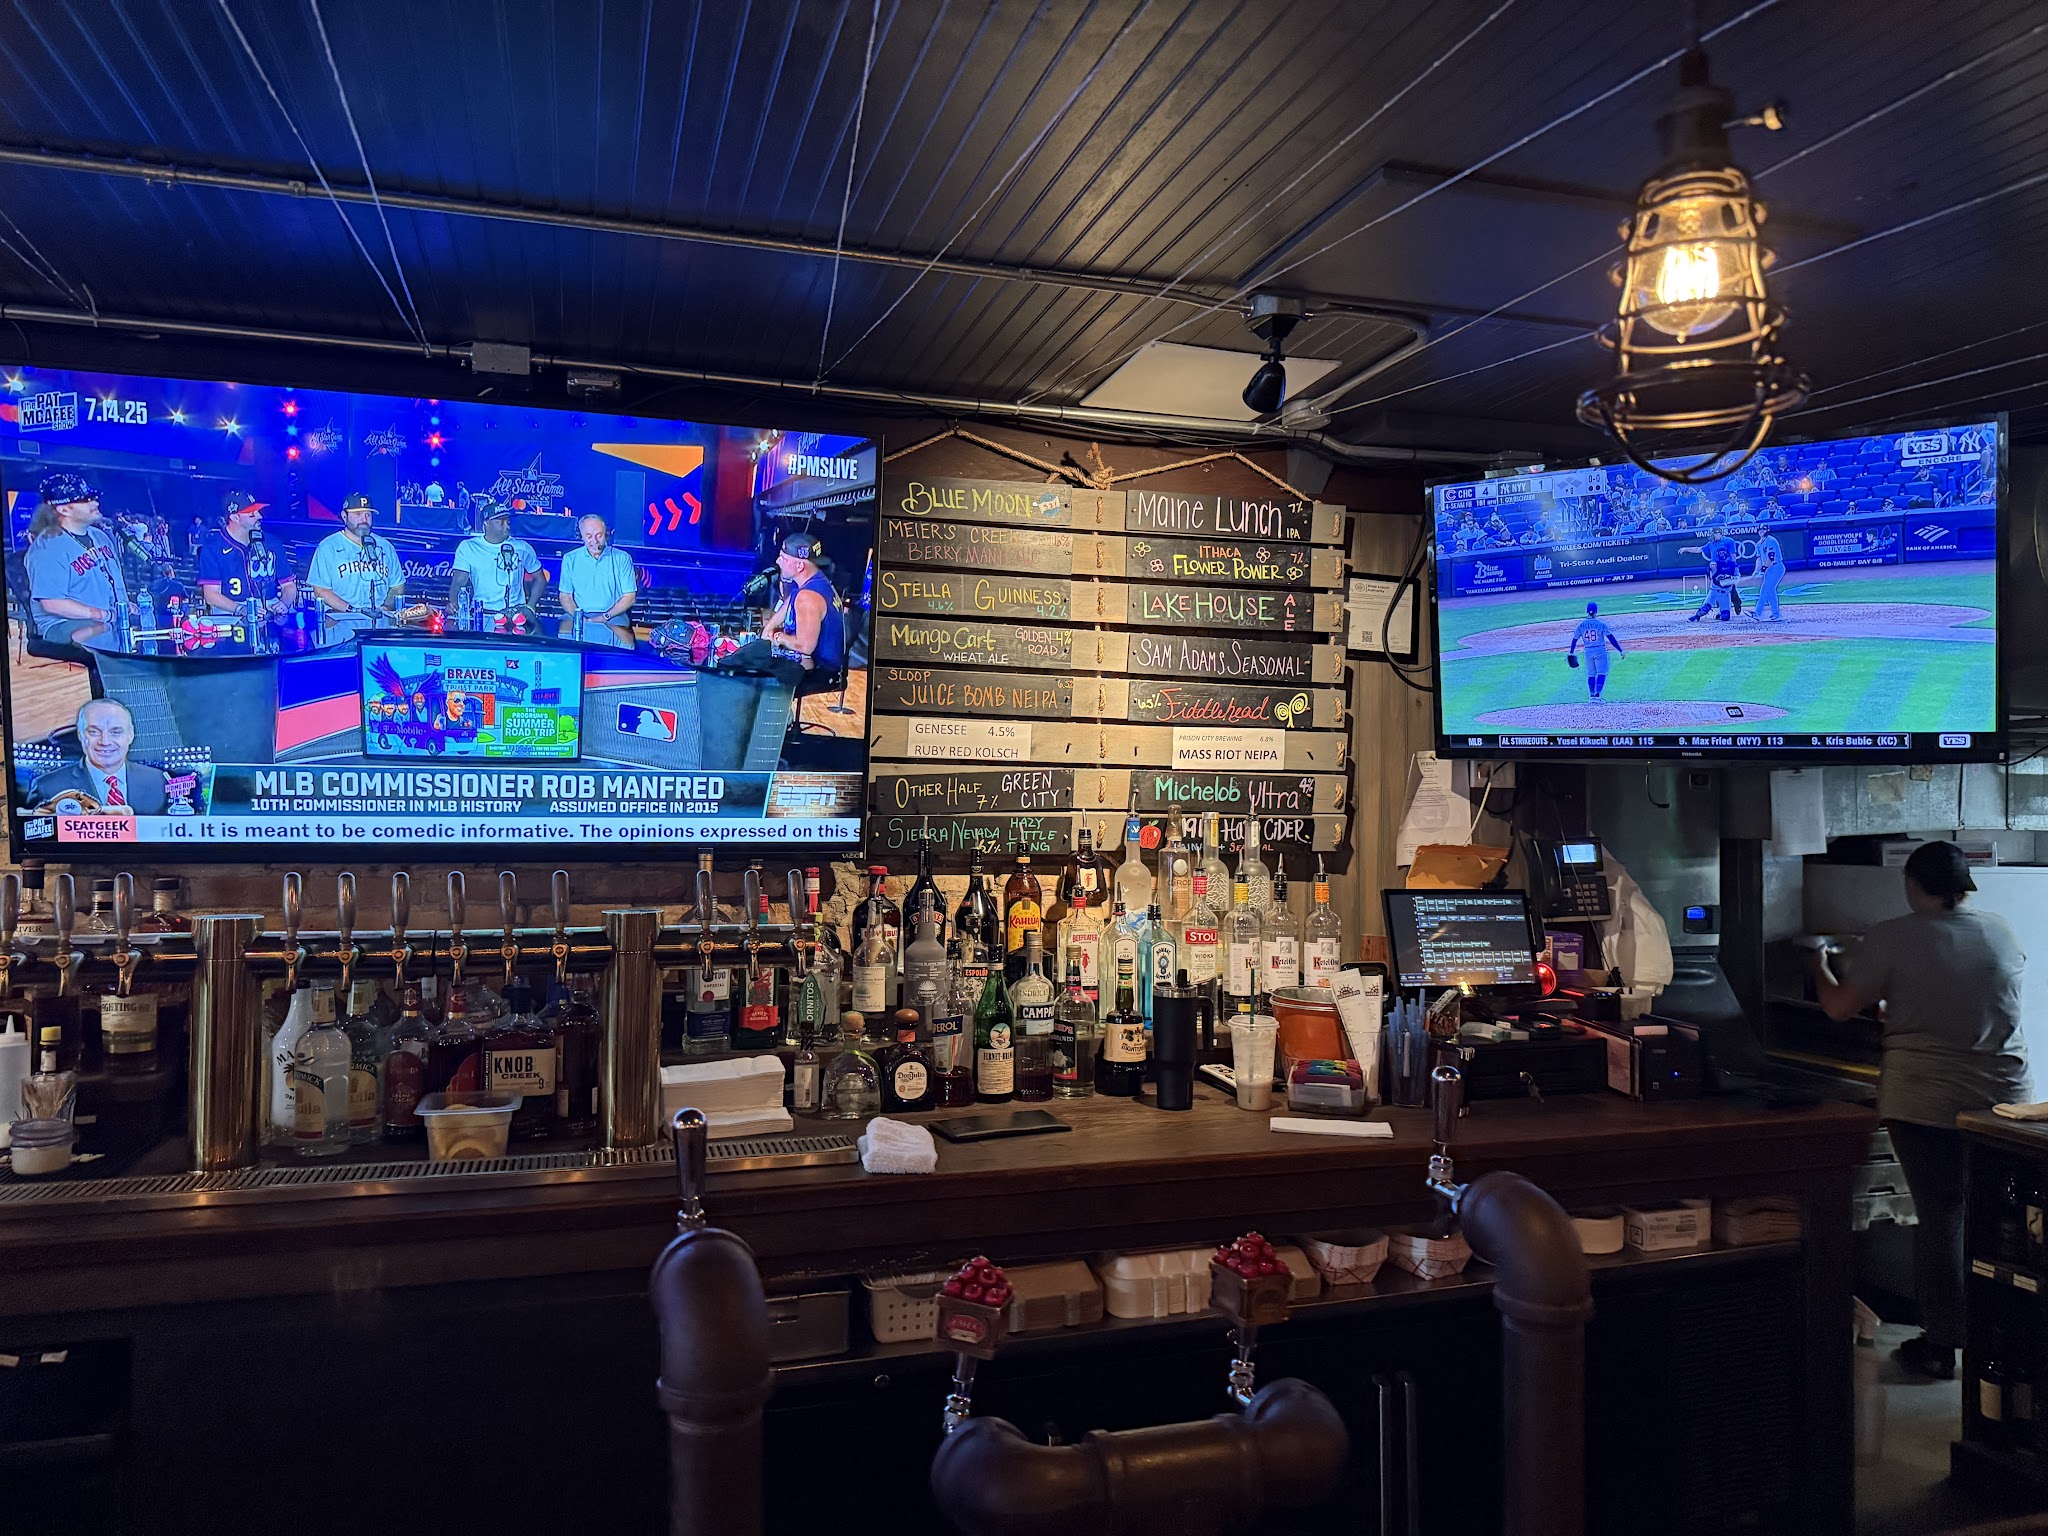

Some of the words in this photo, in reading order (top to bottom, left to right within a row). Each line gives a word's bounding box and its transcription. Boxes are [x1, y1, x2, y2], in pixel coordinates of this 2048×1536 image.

[36, 392, 60, 408] PAT
[23, 406, 75, 425] MCAFEE
[85, 398, 148, 424] 7.14.25
[53, 422, 73, 430] show
[1909, 438, 1942, 453] YES
[788, 454, 858, 480] #PMSLIVE
[1918, 455, 1962, 465] ENCORE
[512, 478, 536, 494] Star
[1457, 489, 1473, 498] CHC
[1482, 487, 1489, 495] 4
[1512, 483, 1526, 492] NYY
[1538, 481, 1544, 489] 1
[901, 482, 968, 516] BLUE
[972, 488, 1032, 517] MOON
[1138, 491, 1204, 530] Maine
[1215, 496, 1283, 538] Lunch
[1288, 501, 1304, 514] 7%
[889, 520, 956, 541] MEIER'S
[970, 527, 1018, 546] CREEK
[1287, 527, 1301, 540] IPA
[908, 542, 962, 562] BERRY
[1200, 545, 1242, 559] ITHACA
[1291, 552, 1305, 565] 7%
[1173, 554, 1230, 576] FLOWER
[1232, 557, 1284, 580] POWER
[1559, 559, 1595, 567] Tri-State
[1597, 557, 1615, 565] Audi
[1617, 554, 1649, 562] Dealers
[230, 577, 242, 595] 3
[881, 572, 952, 608] STELLA
[974, 578, 1062, 612] GUINNESS
[928, 600, 954, 611] 4.6%
[1036, 605, 1068, 618] 4.2%
[1284, 593, 1296, 631] ALE
[891, 624, 950, 654] Mango
[954, 627, 997, 651] Cart
[1015, 627, 1052, 644] GOLDEN
[1585, 629, 1597, 641] 48
[1028, 644, 1058, 656] ROAD
[1136, 638, 1172, 668] SAM
[1179, 639, 1225, 676] ADAMS
[1226, 640, 1306, 677] SEASONAL
[943, 652, 984, 662] WHEAT
[988, 654, 1010, 664] ALE
[447, 668, 496, 680] BRAVES
[888, 669, 931, 682] SLOOP
[474, 684, 495, 692] PARK
[900, 684, 955, 706] JUICE
[963, 685, 1006, 708] BOMB
[1012, 689, 1058, 713] NEIPA
[1156, 688, 1270, 723] Fiddlehead
[506, 719, 556, 730] SUMMER
[915, 723, 967, 736] GENESEE
[988, 726, 1016, 737] 4.5%
[505, 728, 532, 738] ROAD
[534, 728, 556, 738] TRIP
[1468, 737, 1483, 746] MLB
[1501, 737, 1510, 745] AL
[1511, 737, 1549, 745] STRIKEOUTS
[1557, 737, 1578, 746] Yusei
[1580, 737, 1608, 746] Kikuchi
[1612, 737, 1634, 747] (LAA)
[1638, 737, 1654, 746] 115
[1692, 737, 1709, 746] Max
[1711, 737, 1732, 746] Fried
[1736, 737, 1761, 746] (NYY)
[1766, 737, 1784, 746] 113
[1811, 737, 1821, 746] 9.
[1825, 736, 1844, 746] Kris
[1845, 736, 1872, 746] Bubic
[1877, 736, 1898, 746] (KC)
[1943, 737, 1966, 745] YES
[914, 745, 946, 757] RUBY
[949, 746, 972, 757] RED
[975, 747, 1019, 759] KOLSCH
[1179, 749, 1213, 760] MASS
[1215, 750, 1242, 760] RIOT
[1244, 750, 1278, 761] NEIPA
[255, 770, 315, 796] MLB
[322, 771, 535, 798] COMMISSIONER
[541, 775, 597, 799] ROB
[602, 776, 725, 801] MANFRED
[1001, 770, 1053, 794] GREEN
[776, 786, 837, 806] ESPN
[895, 777, 944, 809] OTHER
[946, 777, 983, 806] HALF
[1021, 789, 1060, 809] CITY
[1155, 776, 1241, 802] Michelob
[1248, 780, 1300, 810] Ultra
[1299, 776, 1315, 794] 4%
[251, 799, 290, 812] 10TH
[293, 799, 406, 813] COMMISSIONER
[409, 800, 424, 812] IN
[427, 800, 458, 813] MLB
[460, 801, 522, 813] HISTORY
[550, 801, 617, 814] ASSUMED
[619, 802, 667, 814] OFFICE
[670, 802, 684, 814] IN
[686, 802, 719, 814] 2015
[64, 820, 130, 832] SEATGEEK
[1010, 817, 1045, 830] HAZY
[76, 830, 119, 840] TICKER
[200, 823, 216, 837] It
[222, 824, 238, 837] is
[245, 824, 310, 838] meant
[316, 824, 335, 838] to
[343, 824, 366, 838] be
[372, 824, 455, 838] comedic
[461, 824, 574, 838] informative.
[580, 825, 613, 838] The
[619, 824, 694, 841] opinions
[700, 824, 787, 841] expressed
[792, 826, 812, 838] on
[818, 824, 849, 838] this
[1008, 829, 1058, 841] LTTLE
[1006, 842, 1050, 852] TNG
[1009, 915, 1040, 929] KAHLÚA
[1072, 934, 1098, 942] BEEFEATER
[494, 1056, 534, 1074] KNOB
[501, 1072, 541, 1080] CREEK
[538, 1077, 544, 1089] 9
